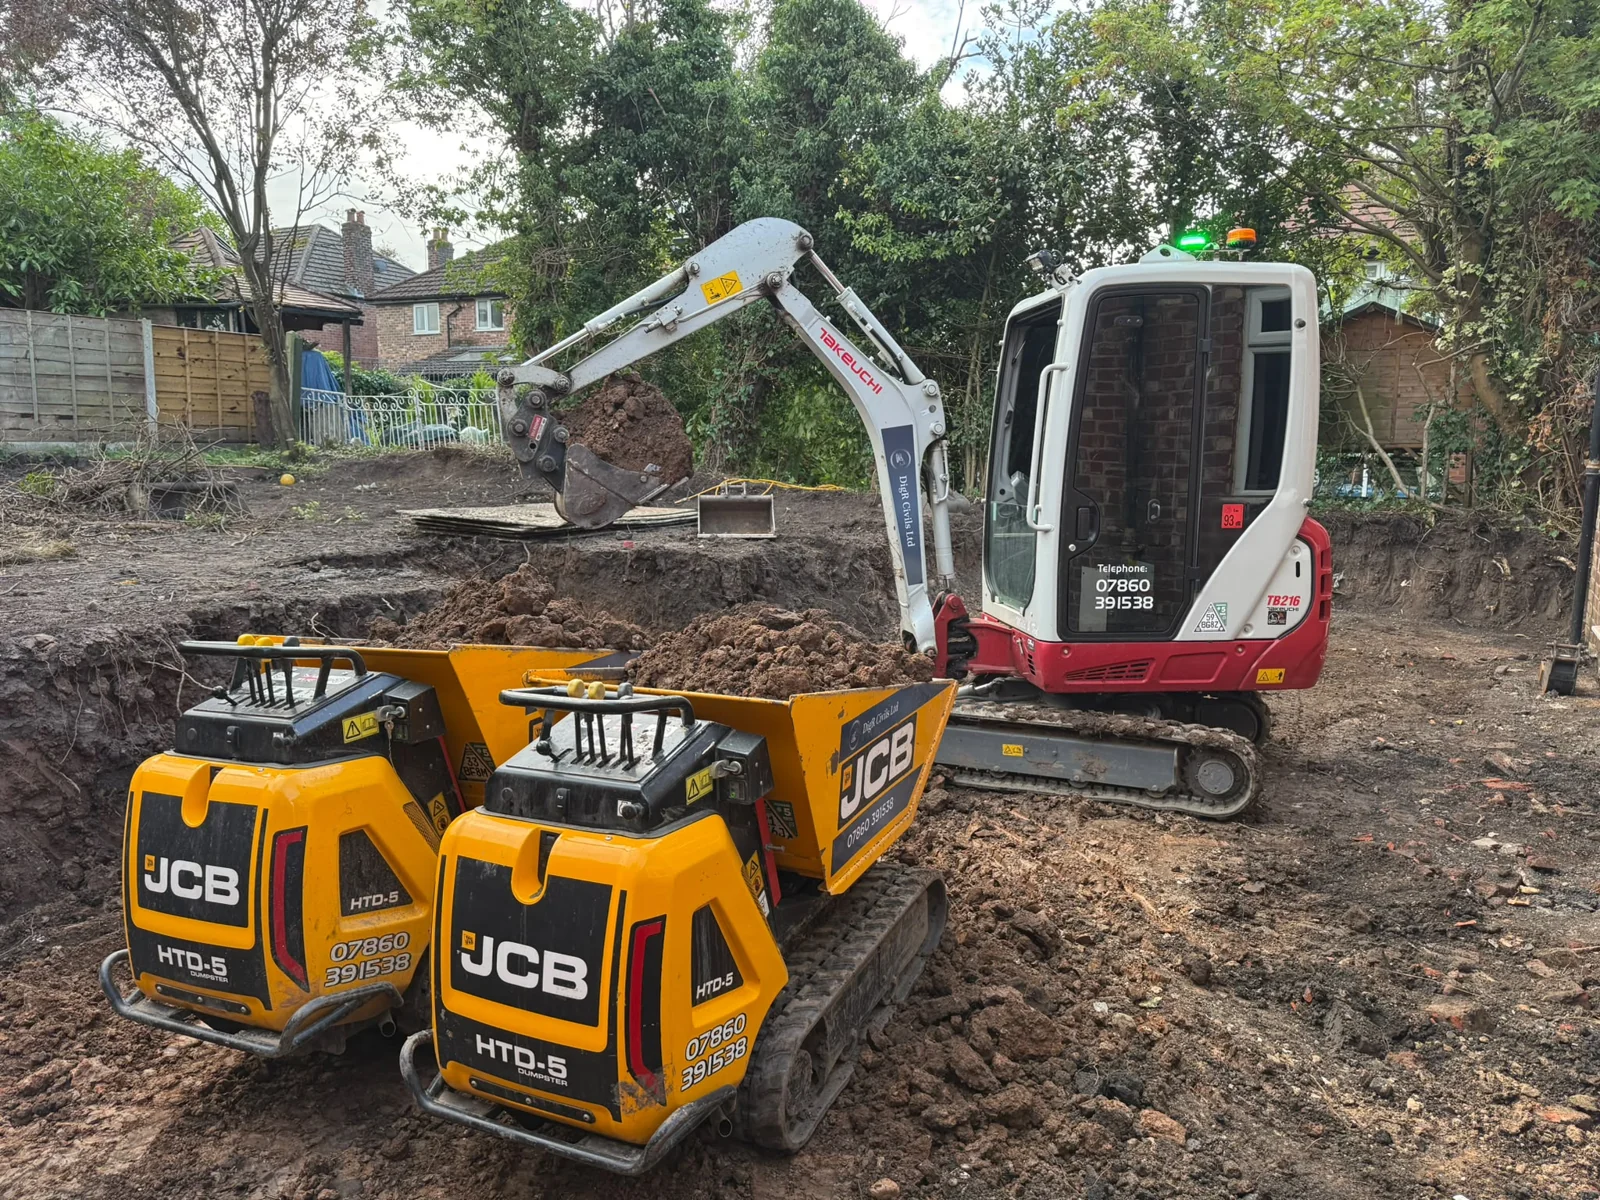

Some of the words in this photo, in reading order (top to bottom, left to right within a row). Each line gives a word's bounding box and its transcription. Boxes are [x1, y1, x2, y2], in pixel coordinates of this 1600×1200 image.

[898, 475, 909, 500] DigR
[902, 501, 913, 529] Civils
[1224, 515, 1234, 526] 93
[905, 531, 915, 547] Ltd
[1098, 564, 1148, 575] Telephone:
[1096, 579, 1150, 592] 07860
[1095, 596, 1153, 609] 391538
[1267, 595, 1301, 606] TB216
[862, 717, 876, 734] DigR
[876, 708, 890, 725] Civils
[890, 701, 899, 715] Ltd
[466, 757, 479, 766] 33
[841, 722, 912, 820] JCB
[784, 808, 792, 817] 5
[847, 818, 870, 848] 07860
[871, 797, 894, 826] 391538
[145, 857, 239, 905] JCB
[350, 891, 399, 910] HTD-5
[330, 932, 410, 962] 07860
[157, 945, 227, 977] HTD-5
[325, 953, 411, 987] 391538
[461, 935, 588, 1000] JCB
[190, 970, 229, 983] DUMPSTER
[696, 972, 734, 999] HTD-5
[685, 1013, 747, 1061] 07860
[476, 1034, 568, 1079] HTD-5
[680, 1037, 748, 1092] 391538
[517, 1067, 568, 1087] DUMPSTER
